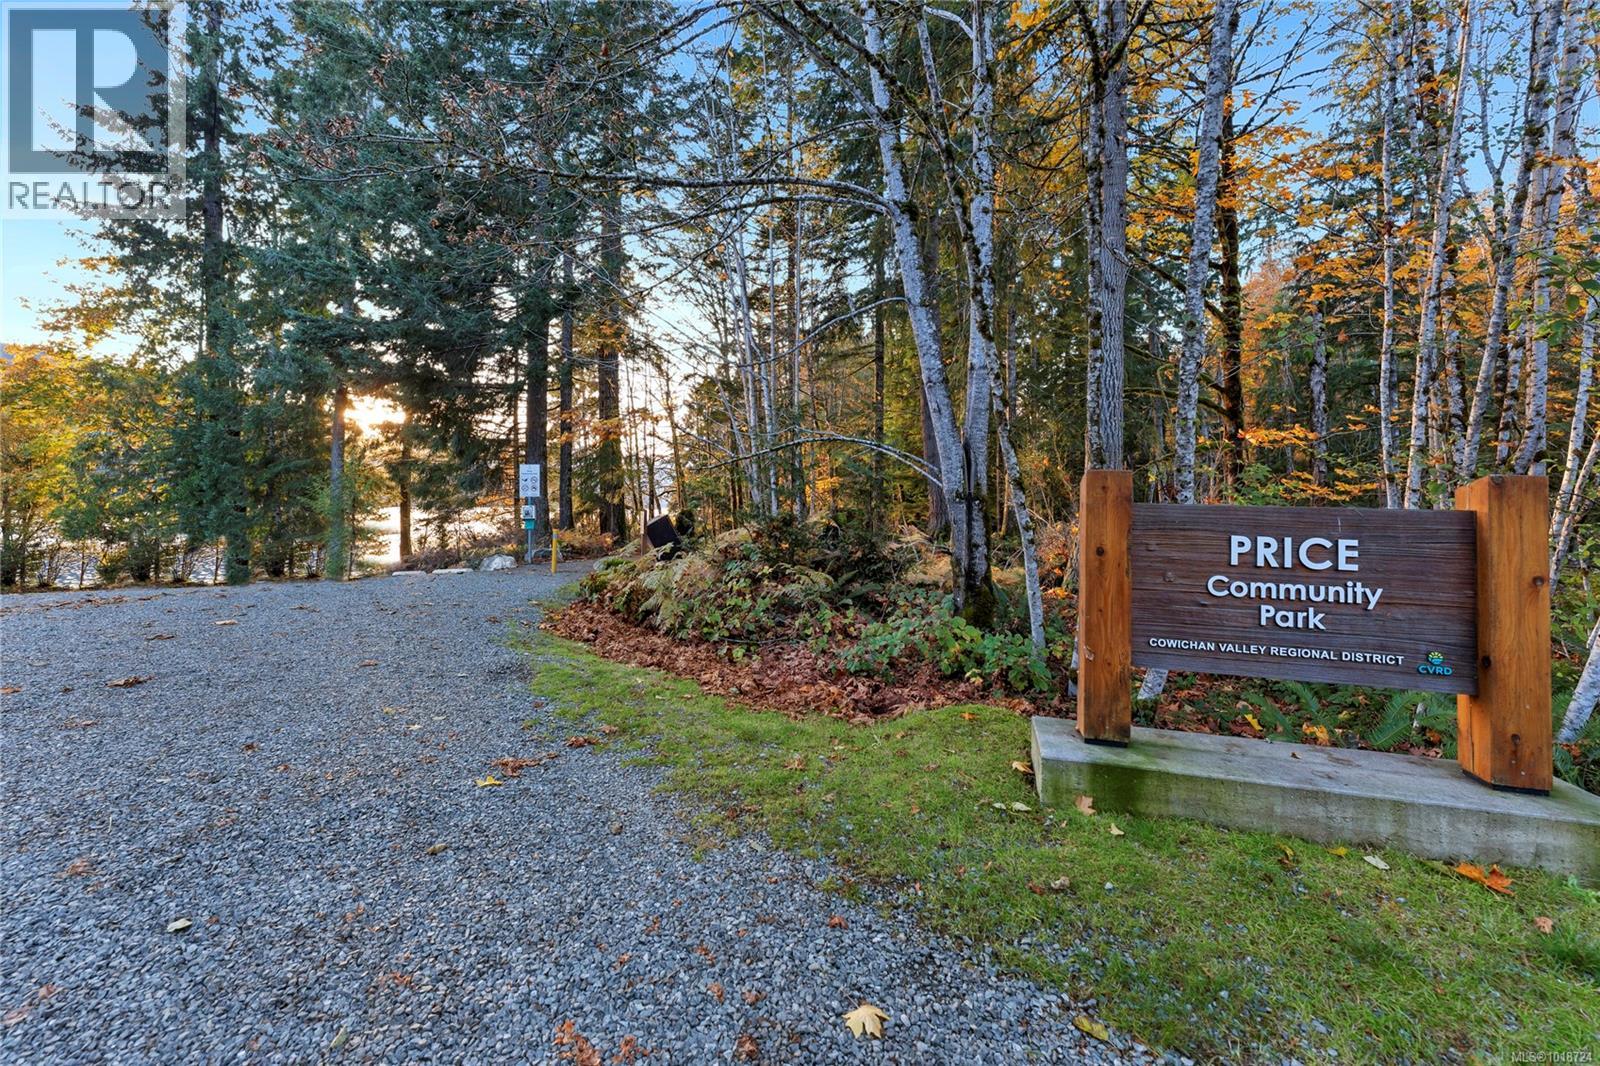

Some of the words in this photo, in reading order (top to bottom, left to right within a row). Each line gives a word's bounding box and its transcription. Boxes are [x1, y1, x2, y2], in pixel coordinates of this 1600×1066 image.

[1229, 535, 1360, 571] PRICE
[1206, 575, 1384, 611] Community
[1258, 605, 1326, 630] Park
[1149, 638, 1216, 651] COWICHAN
[1219, 643, 1267, 655] VALLEY
[1270, 646, 1338, 661] REGIONAL
[1341, 651, 1404, 666] DISTRICT
[1417, 664, 1453, 677] CVRD
